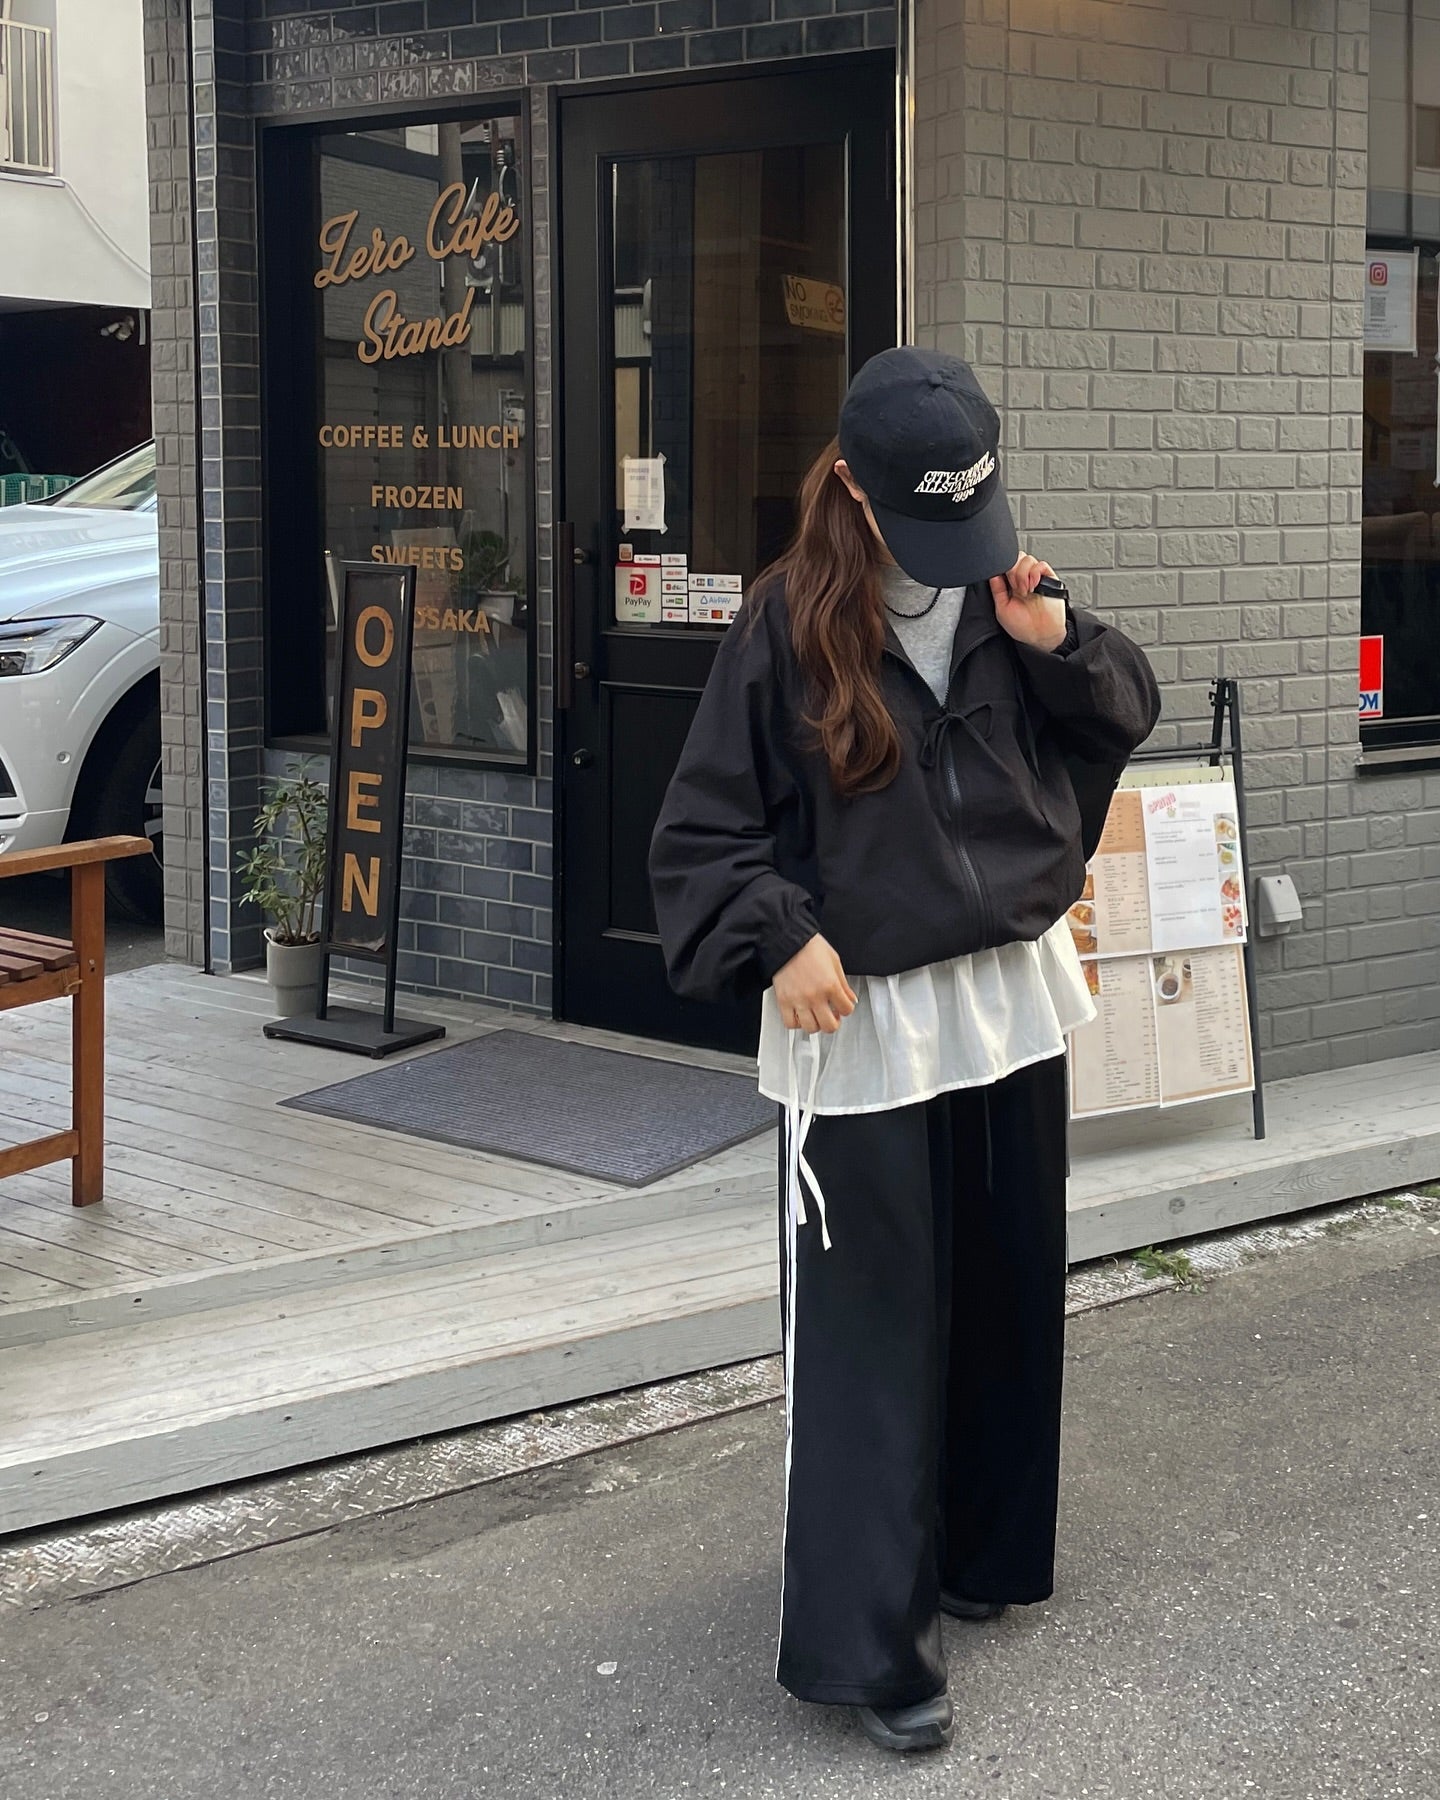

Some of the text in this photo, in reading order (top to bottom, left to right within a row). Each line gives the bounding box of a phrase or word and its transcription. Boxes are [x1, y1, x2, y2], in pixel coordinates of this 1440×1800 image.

[314, 210, 415, 288] Zero
[785, 276, 806, 301] NO
[358, 287, 475, 364] Stand
[319, 425, 520, 449] COFFEE & LUNCH
[371, 485, 463, 509] FROZEN
[952, 488, 975, 503] 1990
[371, 545, 464, 571] SWEETS
[625, 597, 651, 607] PayPay
[341, 605, 394, 916] OPEN
